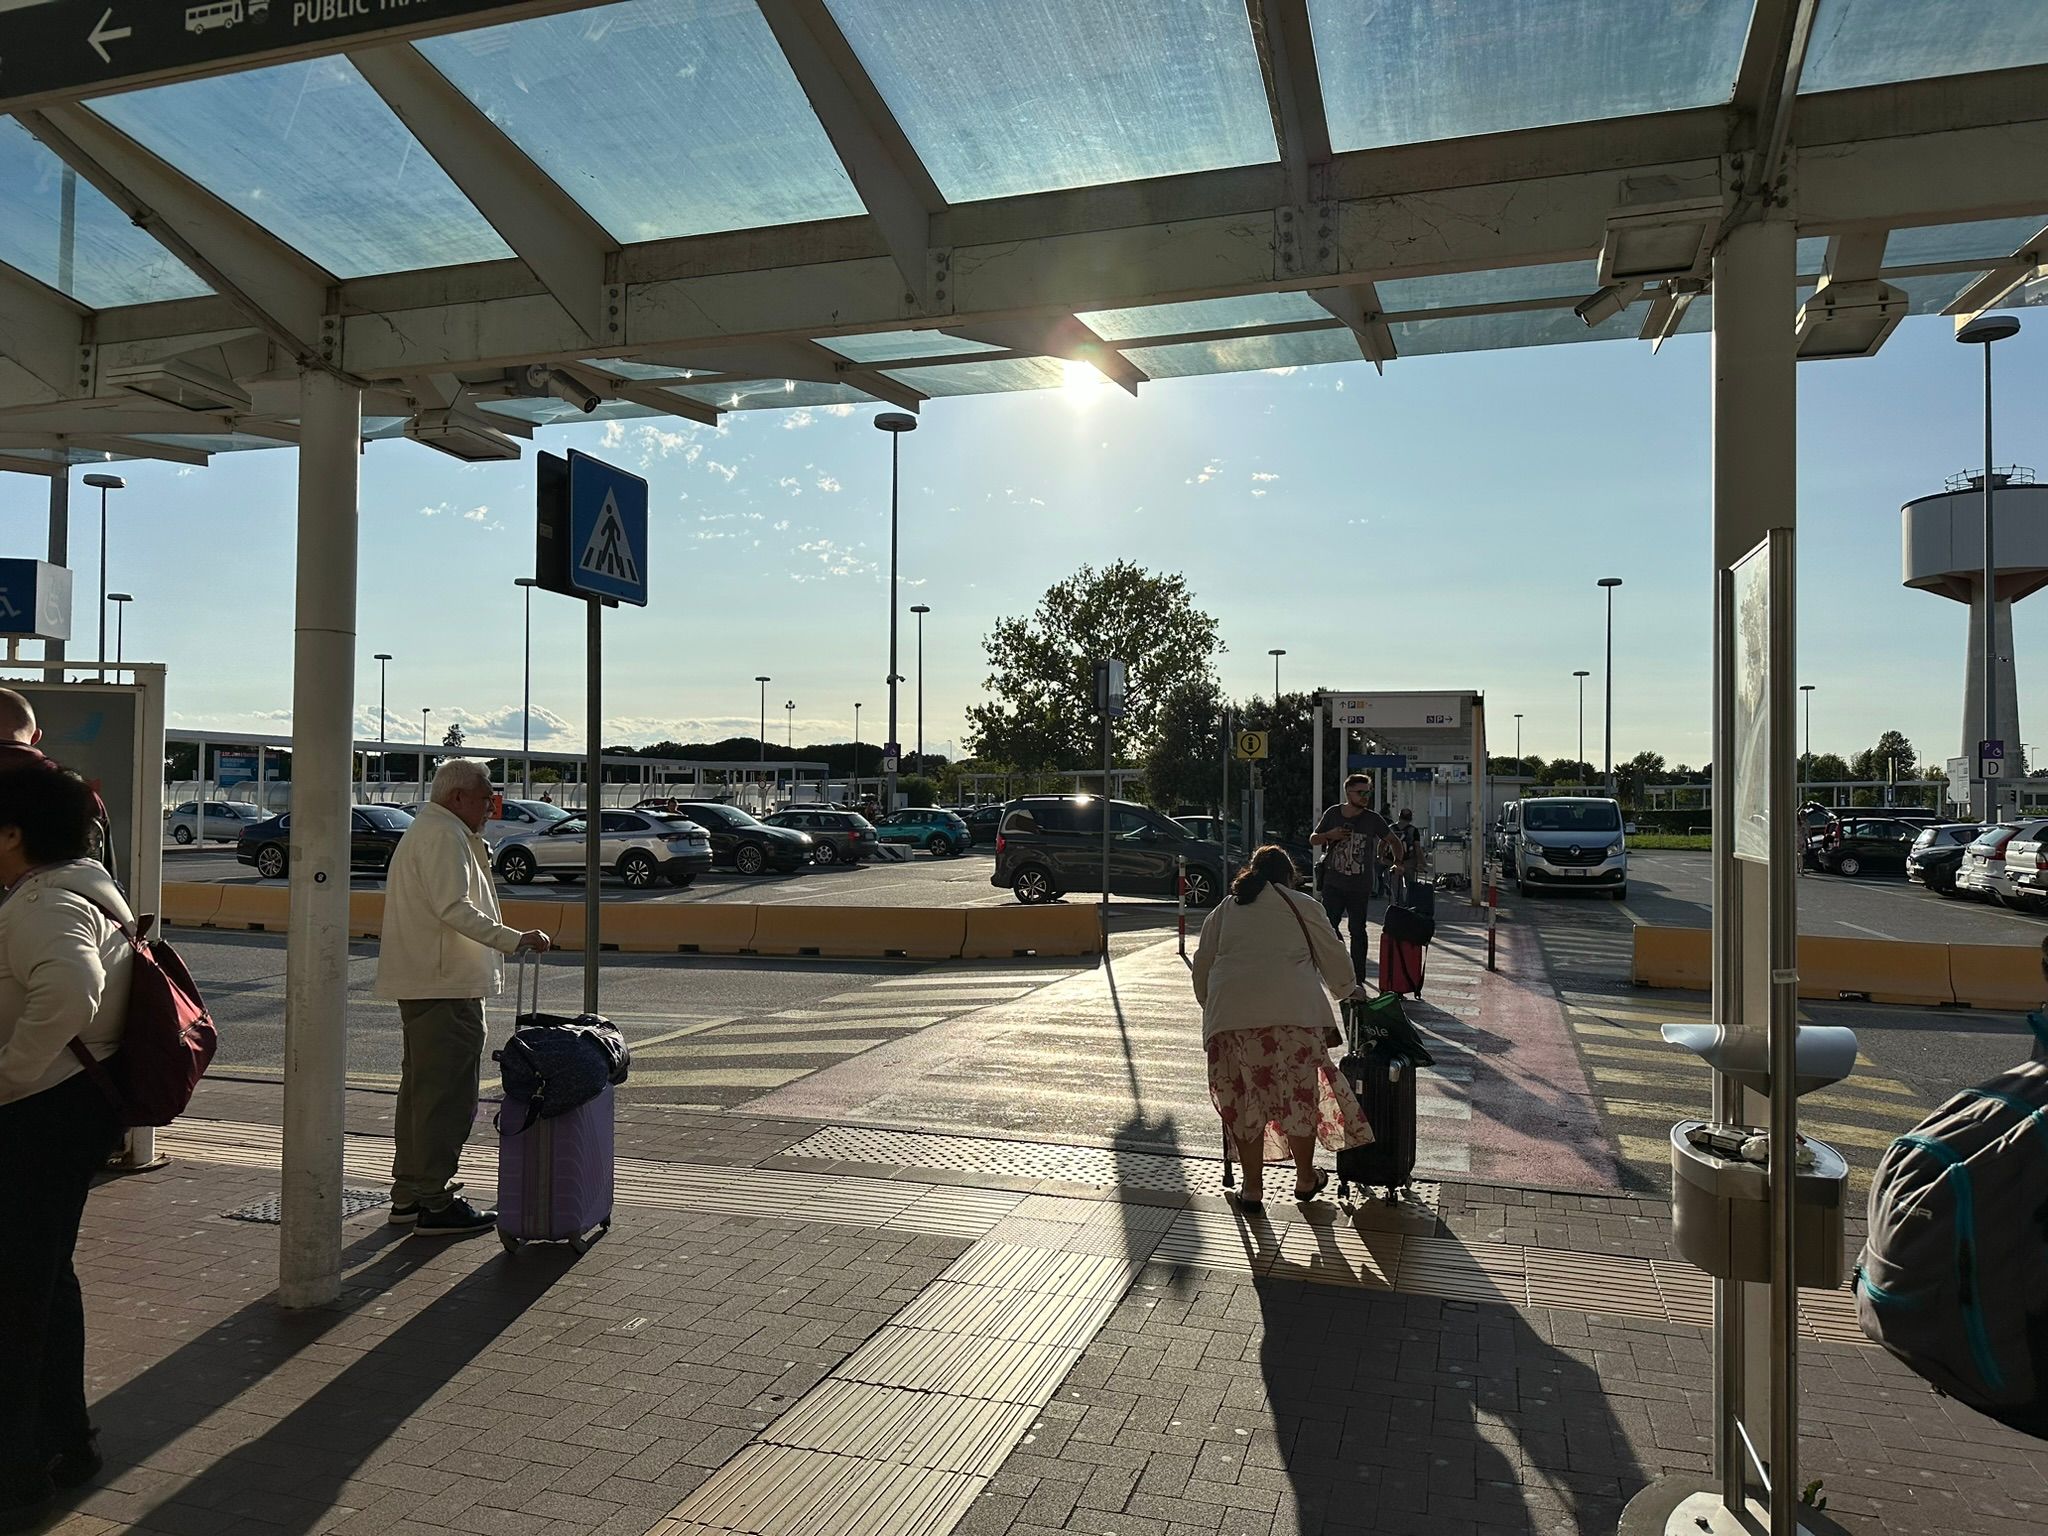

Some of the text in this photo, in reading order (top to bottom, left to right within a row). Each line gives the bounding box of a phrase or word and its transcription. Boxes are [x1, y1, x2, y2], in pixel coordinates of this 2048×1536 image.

[293, 0, 370, 27] PUBLIC
[887, 758, 894, 770] C
[1988, 761, 1999, 775] D
